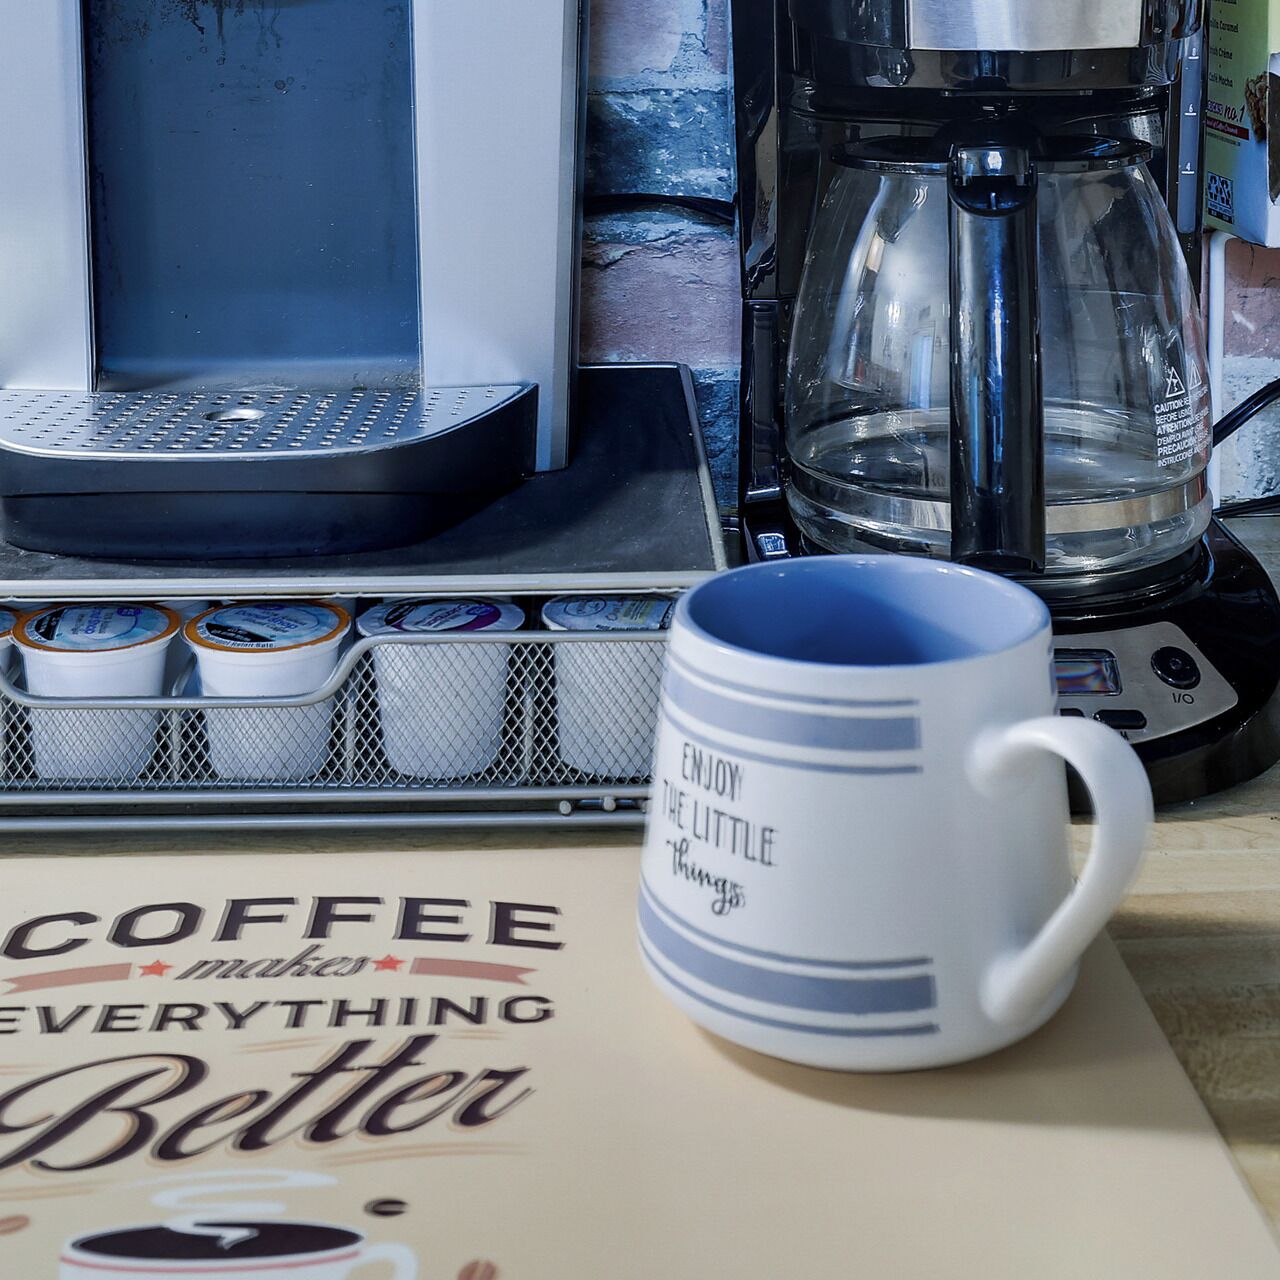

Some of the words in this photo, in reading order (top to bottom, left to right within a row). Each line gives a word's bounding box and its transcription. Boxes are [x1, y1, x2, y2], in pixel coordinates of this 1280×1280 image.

[1155, 411, 1178, 425] BEFORE
[682, 742, 743, 802] ENJOY
[663, 778, 689, 830] THE
[693, 800, 778, 867] LITTLE
[666, 837, 746, 916] things
[175, 945, 370, 981] makes
